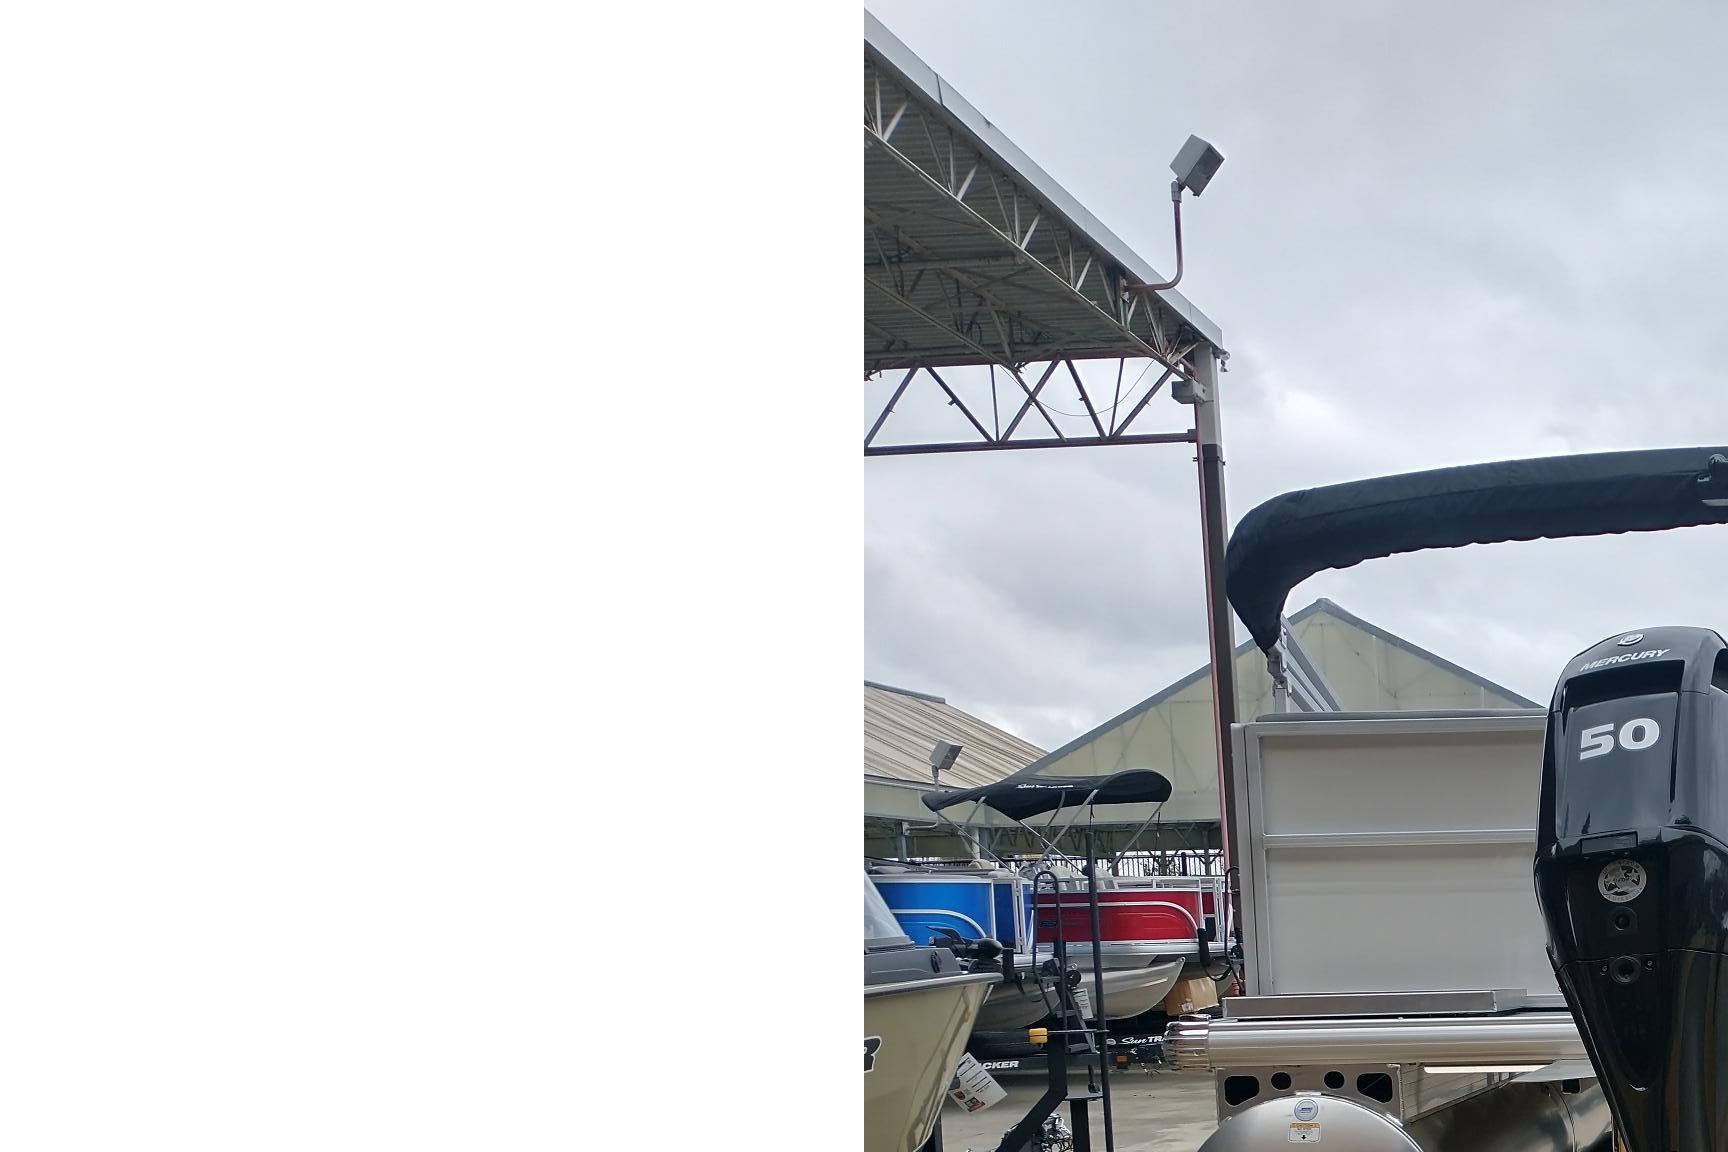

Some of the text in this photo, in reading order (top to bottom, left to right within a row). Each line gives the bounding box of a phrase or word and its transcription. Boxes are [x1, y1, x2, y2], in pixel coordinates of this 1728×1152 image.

[1579, 649, 1671, 672] MERCURY
[1580, 718, 1660, 760] 50
[980, 1060, 1020, 1070] CKER
